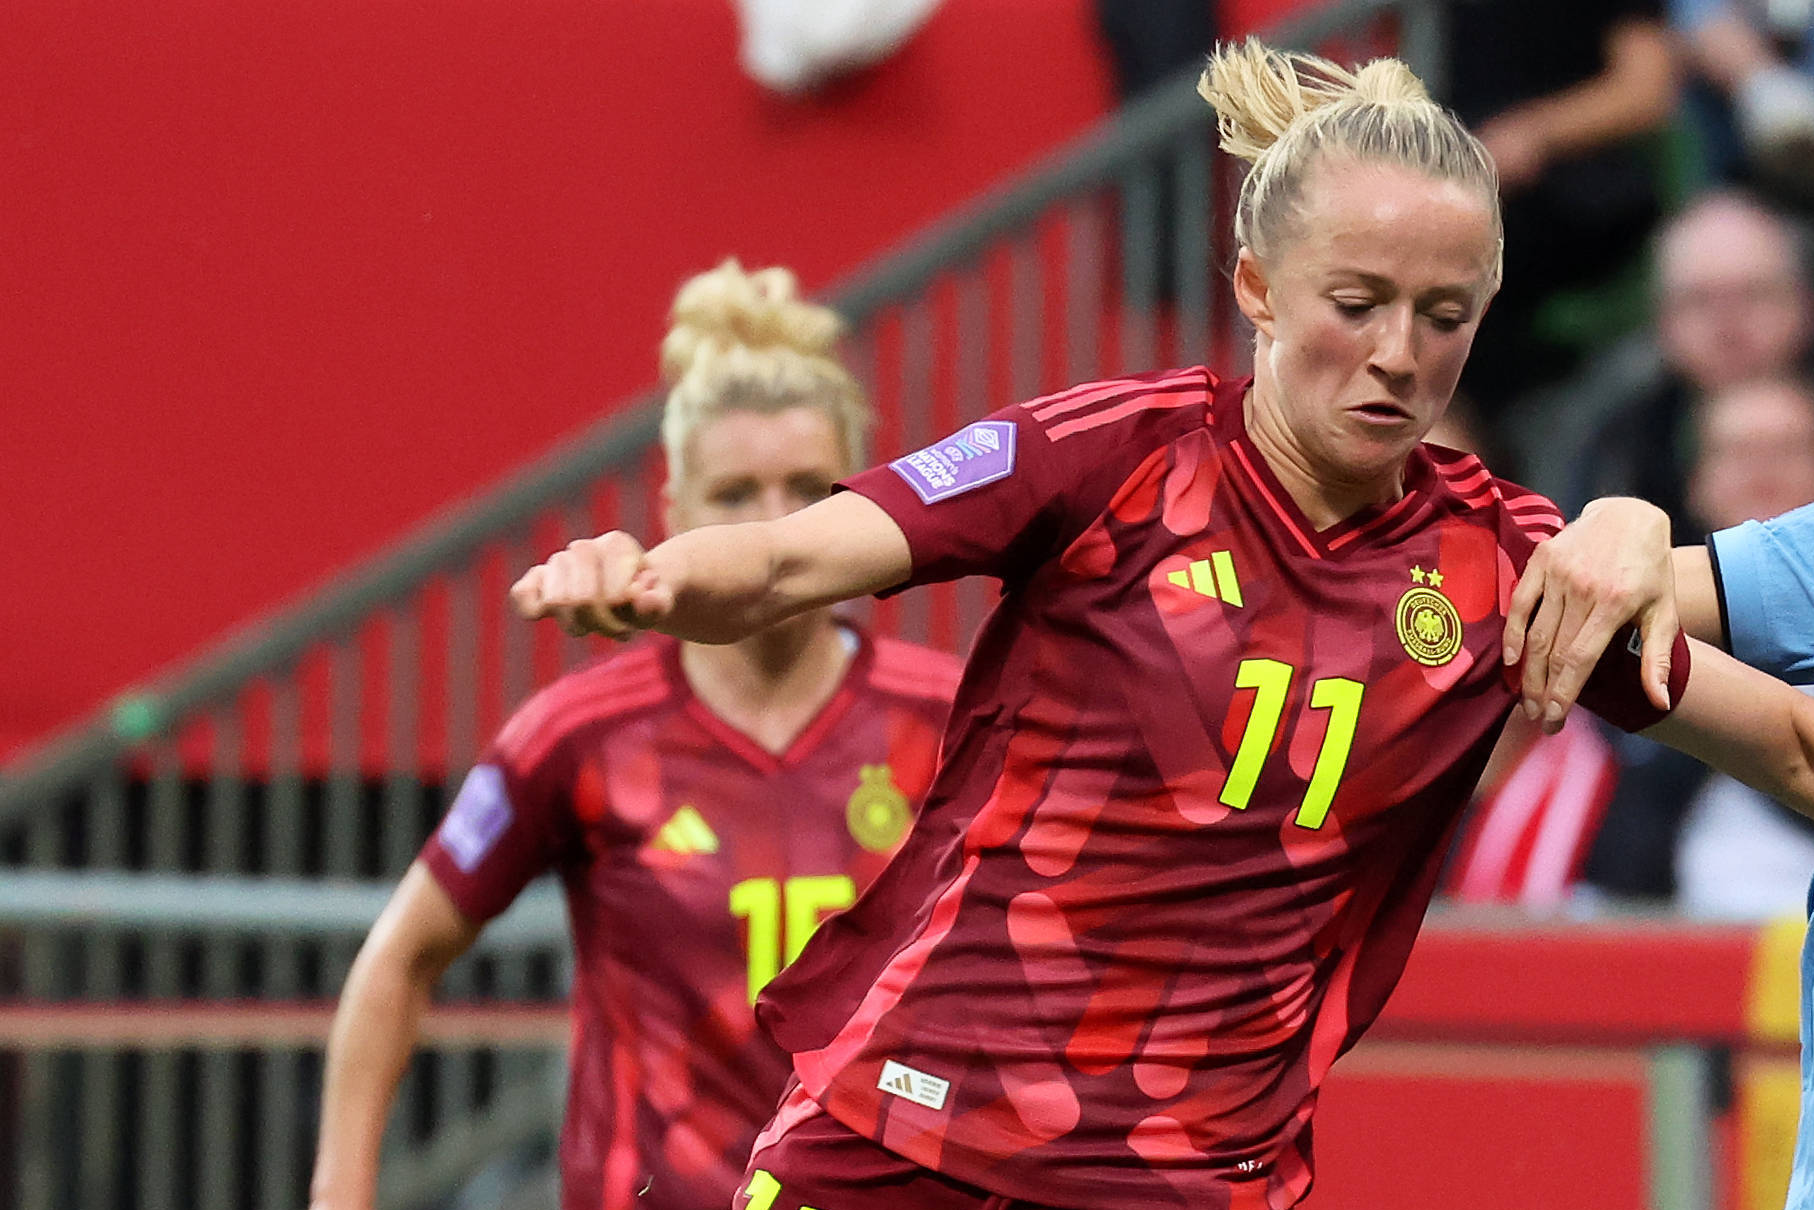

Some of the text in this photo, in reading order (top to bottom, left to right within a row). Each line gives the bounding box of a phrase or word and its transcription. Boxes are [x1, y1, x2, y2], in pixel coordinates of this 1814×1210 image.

[905, 455, 944, 490] LEAGUE
[914, 448, 957, 488] NATIONS
[1218, 657, 1366, 831] 11
